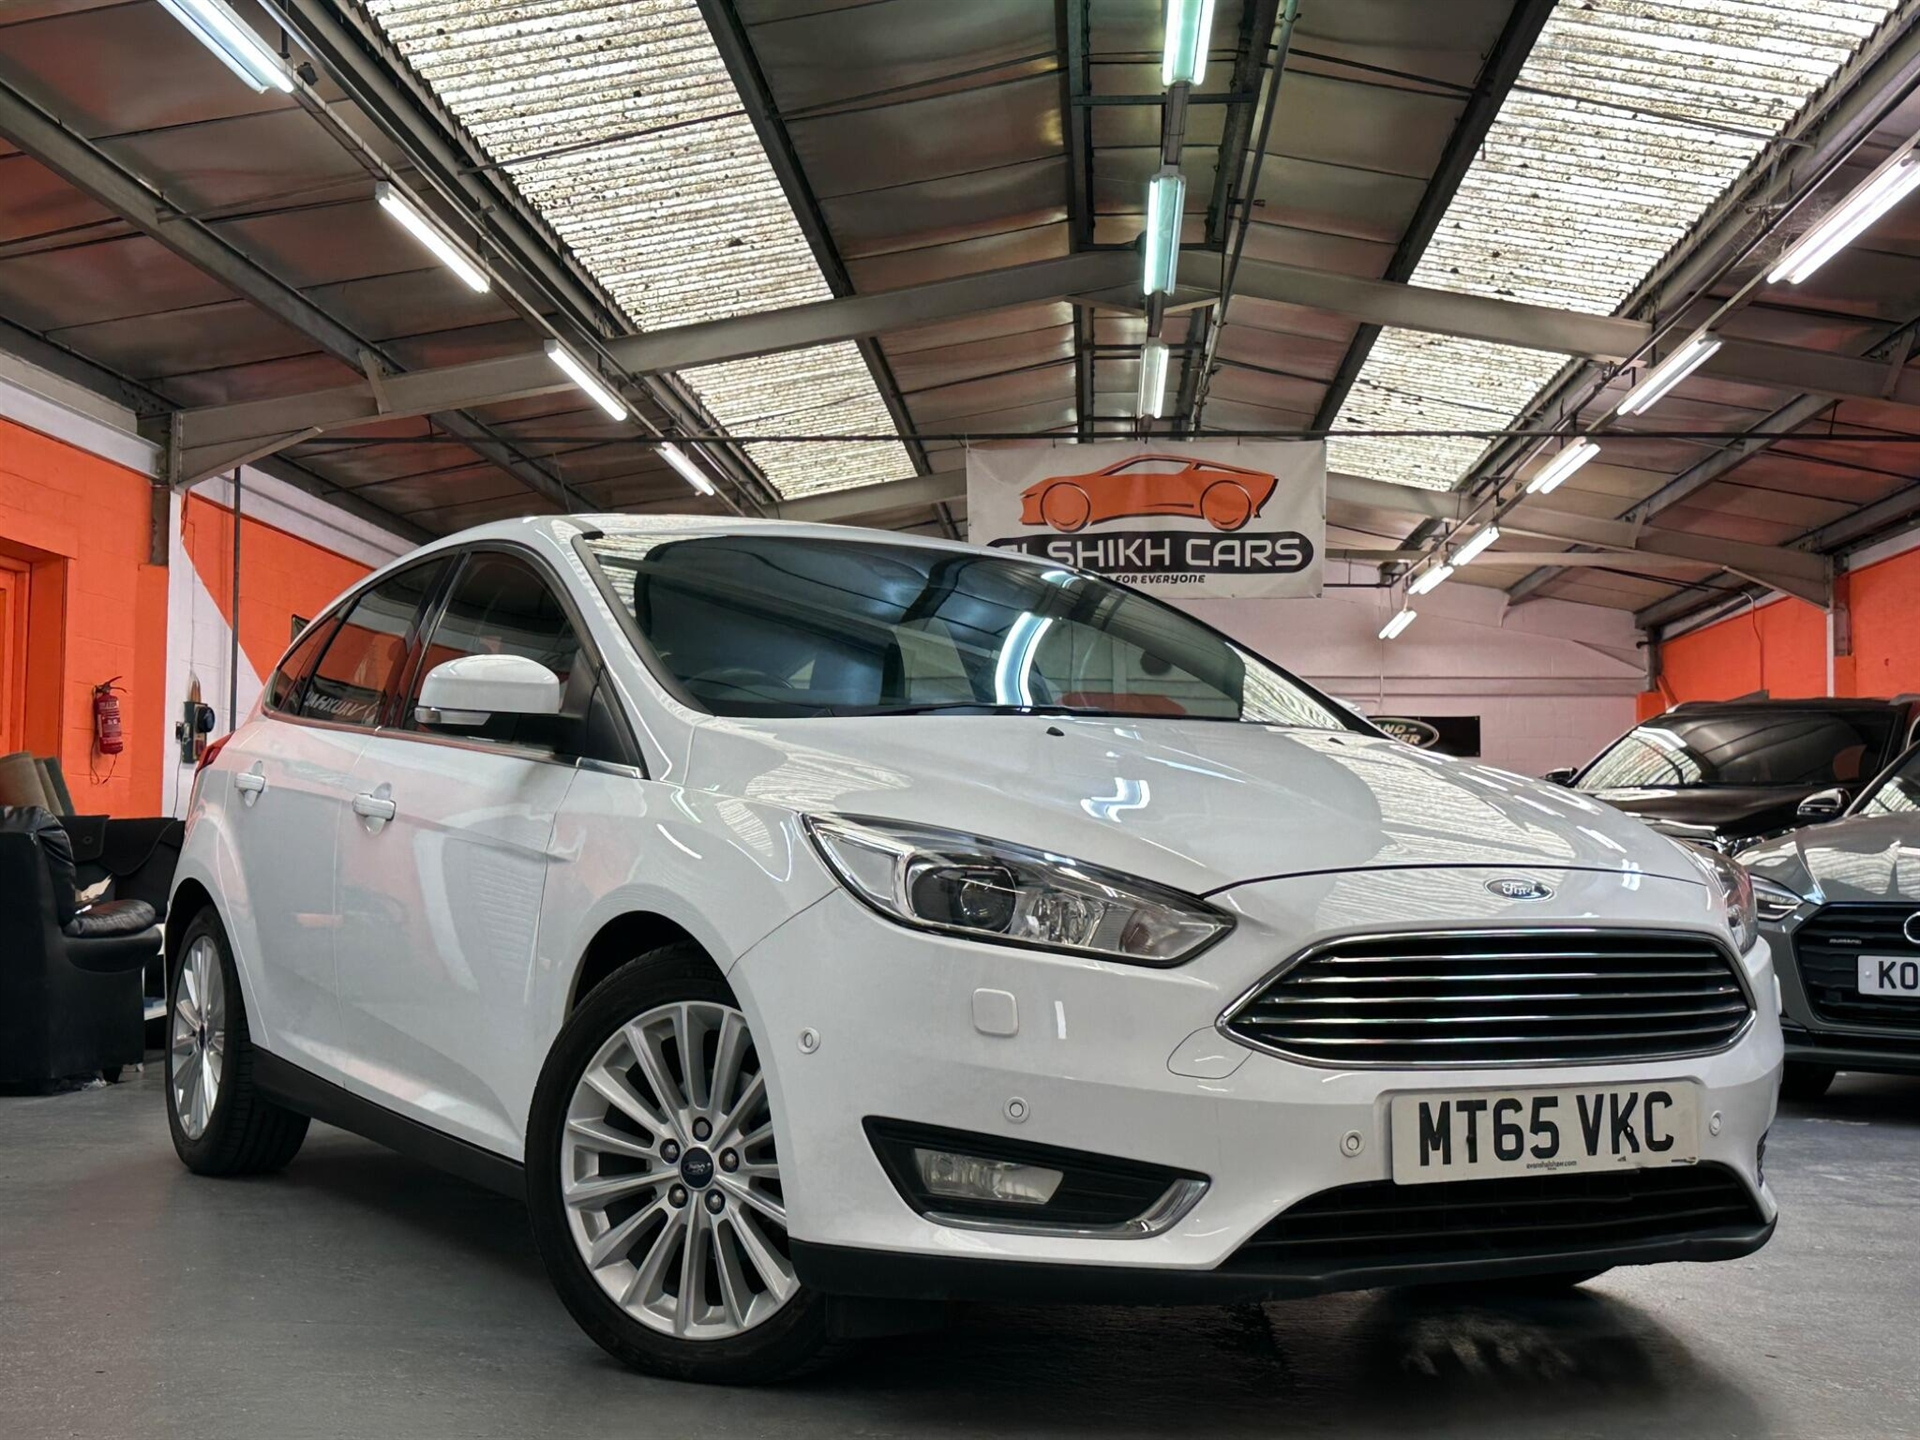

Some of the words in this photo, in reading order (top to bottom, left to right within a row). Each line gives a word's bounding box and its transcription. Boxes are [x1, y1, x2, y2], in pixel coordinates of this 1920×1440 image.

[1047, 538, 1170, 568] SHIKH
[1186, 538, 1302, 567] CARS
[1140, 574, 1206, 585] EVERYONE
[1418, 1096, 1560, 1167] MT65
[1575, 1091, 1675, 1157] VKC
